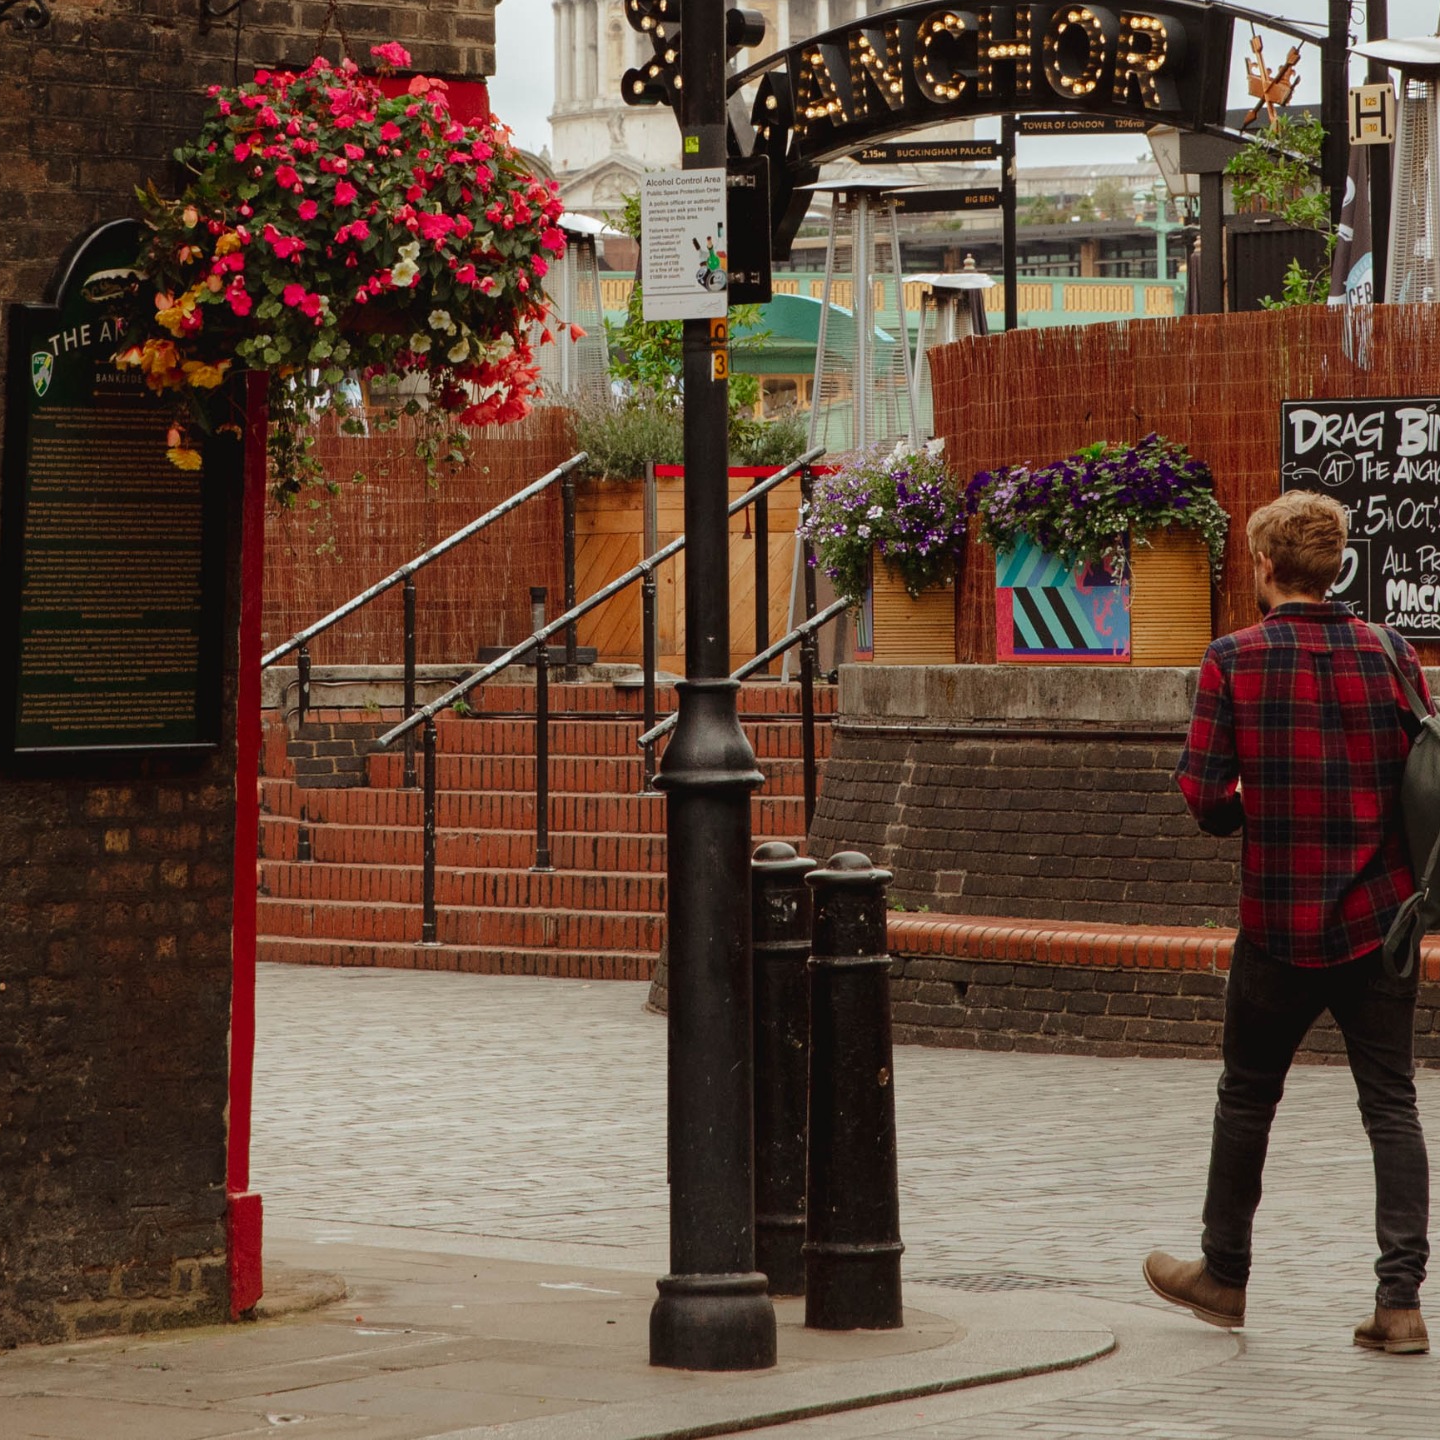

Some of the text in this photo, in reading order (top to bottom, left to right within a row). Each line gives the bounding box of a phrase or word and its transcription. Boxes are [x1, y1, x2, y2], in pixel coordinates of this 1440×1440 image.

[794, 3, 1184, 136] ANCHOR
[1023, 121, 1052, 131] TOWER
[1054, 121, 1066, 129] OF
[1067, 120, 1105, 130] LONDON
[896, 147, 958, 158] BUCKINGHAM
[960, 146, 992, 156] PALACE
[646, 178, 674, 187] Alcohol
[675, 176, 702, 185] Control
[663, 189, 678, 197] Space
[964, 195, 979, 204] BIG
[979, 194, 995, 203] BEN
[48, 324, 91, 357] THE
[715, 355, 725, 375] 3
[95, 373, 143, 383] BANKSIDE
[1288, 409, 1384, 455] DRAG
[1324, 459, 1353, 482] AT
[1355, 451, 1390, 484] THE
[1382, 545, 1412, 576] ALL
[1420, 574, 1438, 585] GO
